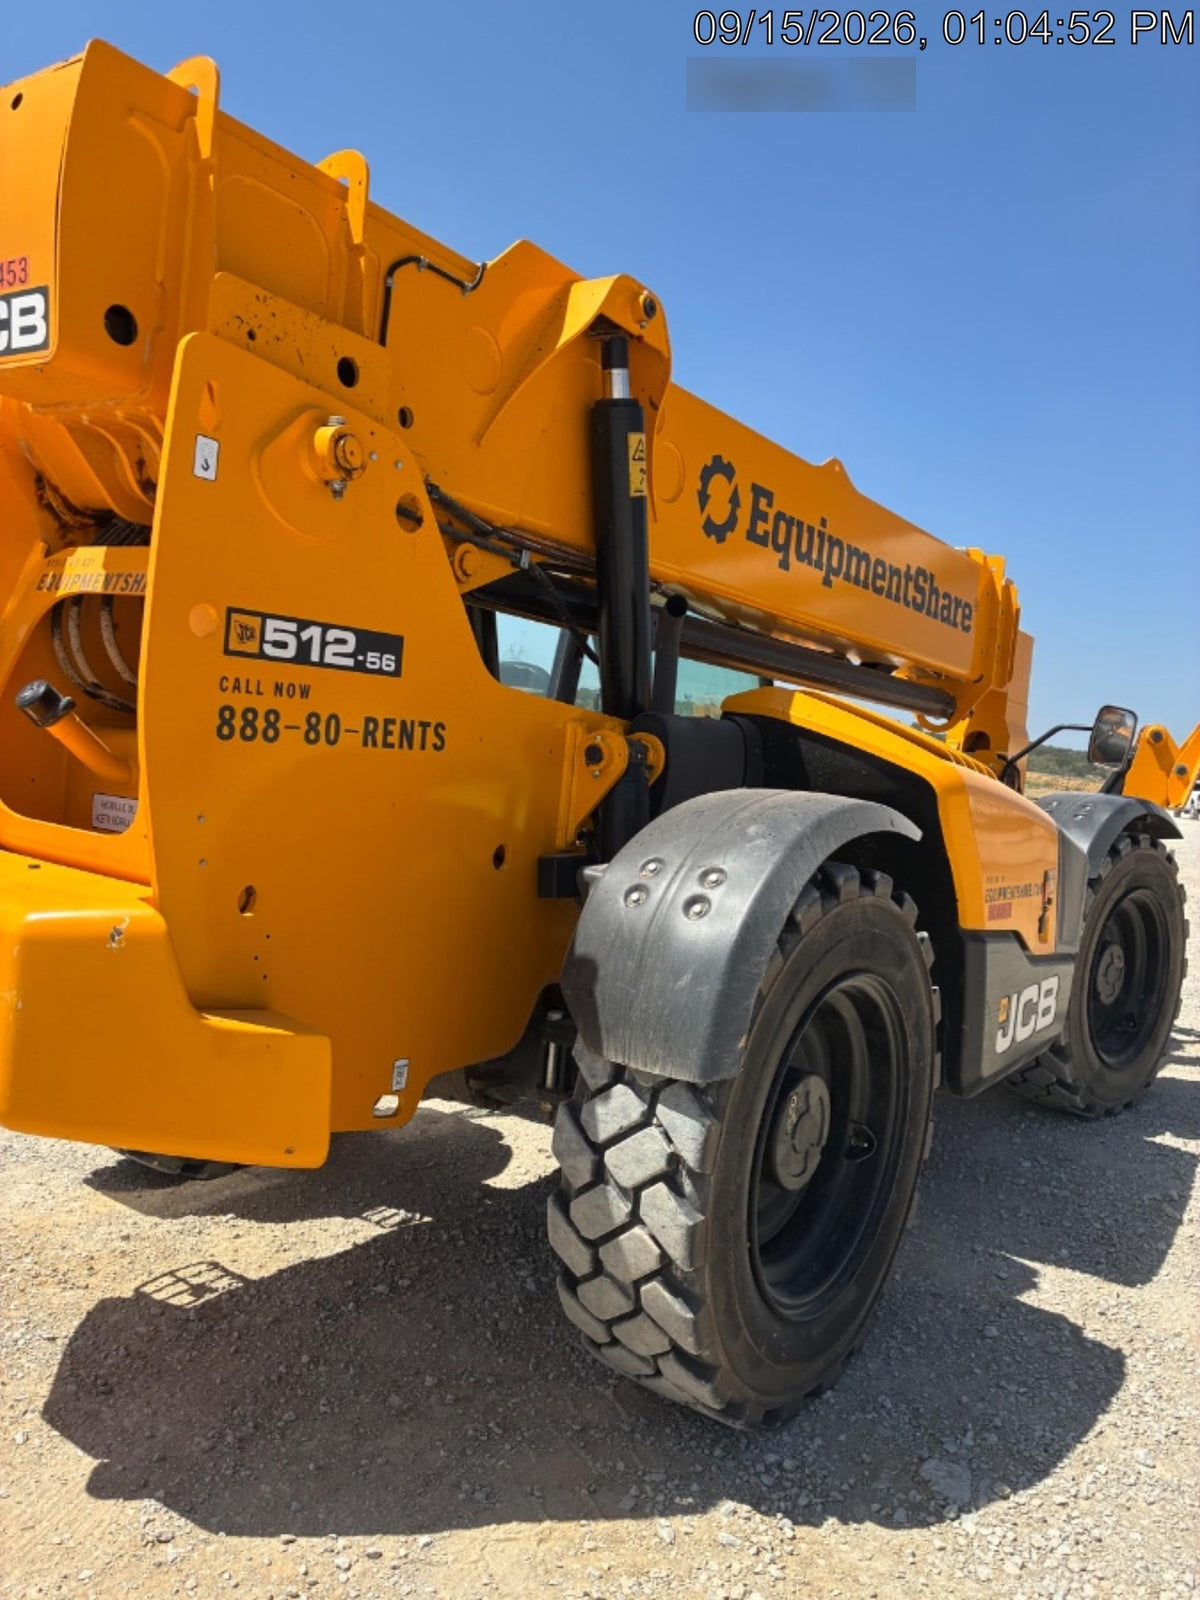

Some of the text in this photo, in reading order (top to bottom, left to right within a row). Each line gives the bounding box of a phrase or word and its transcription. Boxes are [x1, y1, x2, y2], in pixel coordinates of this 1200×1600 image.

[746, 482, 973, 633] EquipmentShare
[219, 676, 311, 700] CALL NOW
[216, 704, 447, 752] 888-80-RENTS
[995, 975, 1059, 1054] JCB
